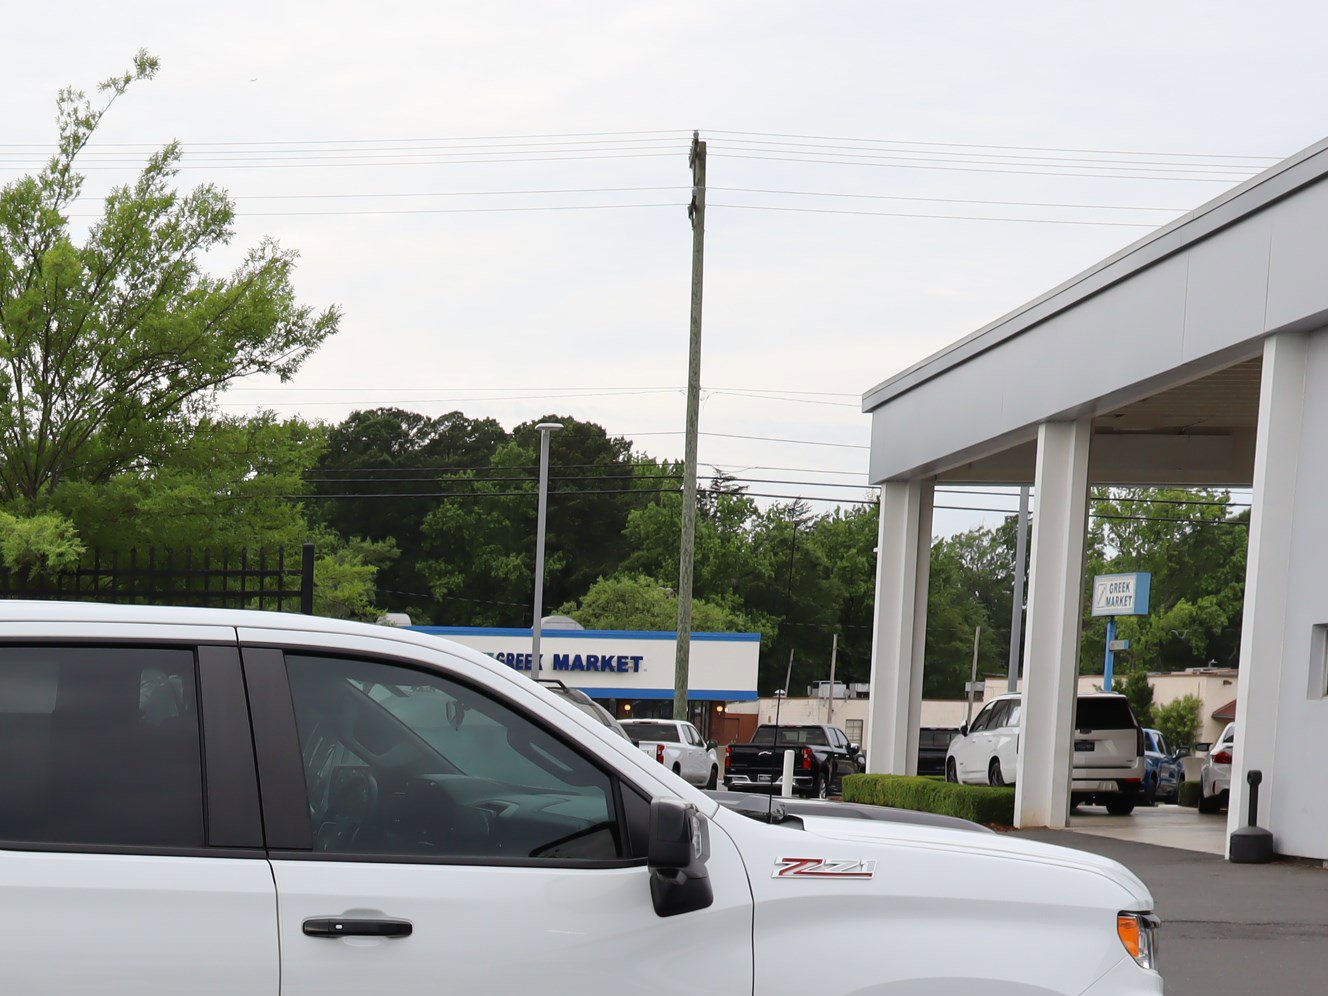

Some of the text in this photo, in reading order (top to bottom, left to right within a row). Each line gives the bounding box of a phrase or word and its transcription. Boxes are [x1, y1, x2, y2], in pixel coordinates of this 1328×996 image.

[1109, 582, 1130, 594] GREEK
[1106, 596, 1133, 607] MARKET
[553, 653, 644, 673] MARKET
[771, 856, 877, 880] Z71
